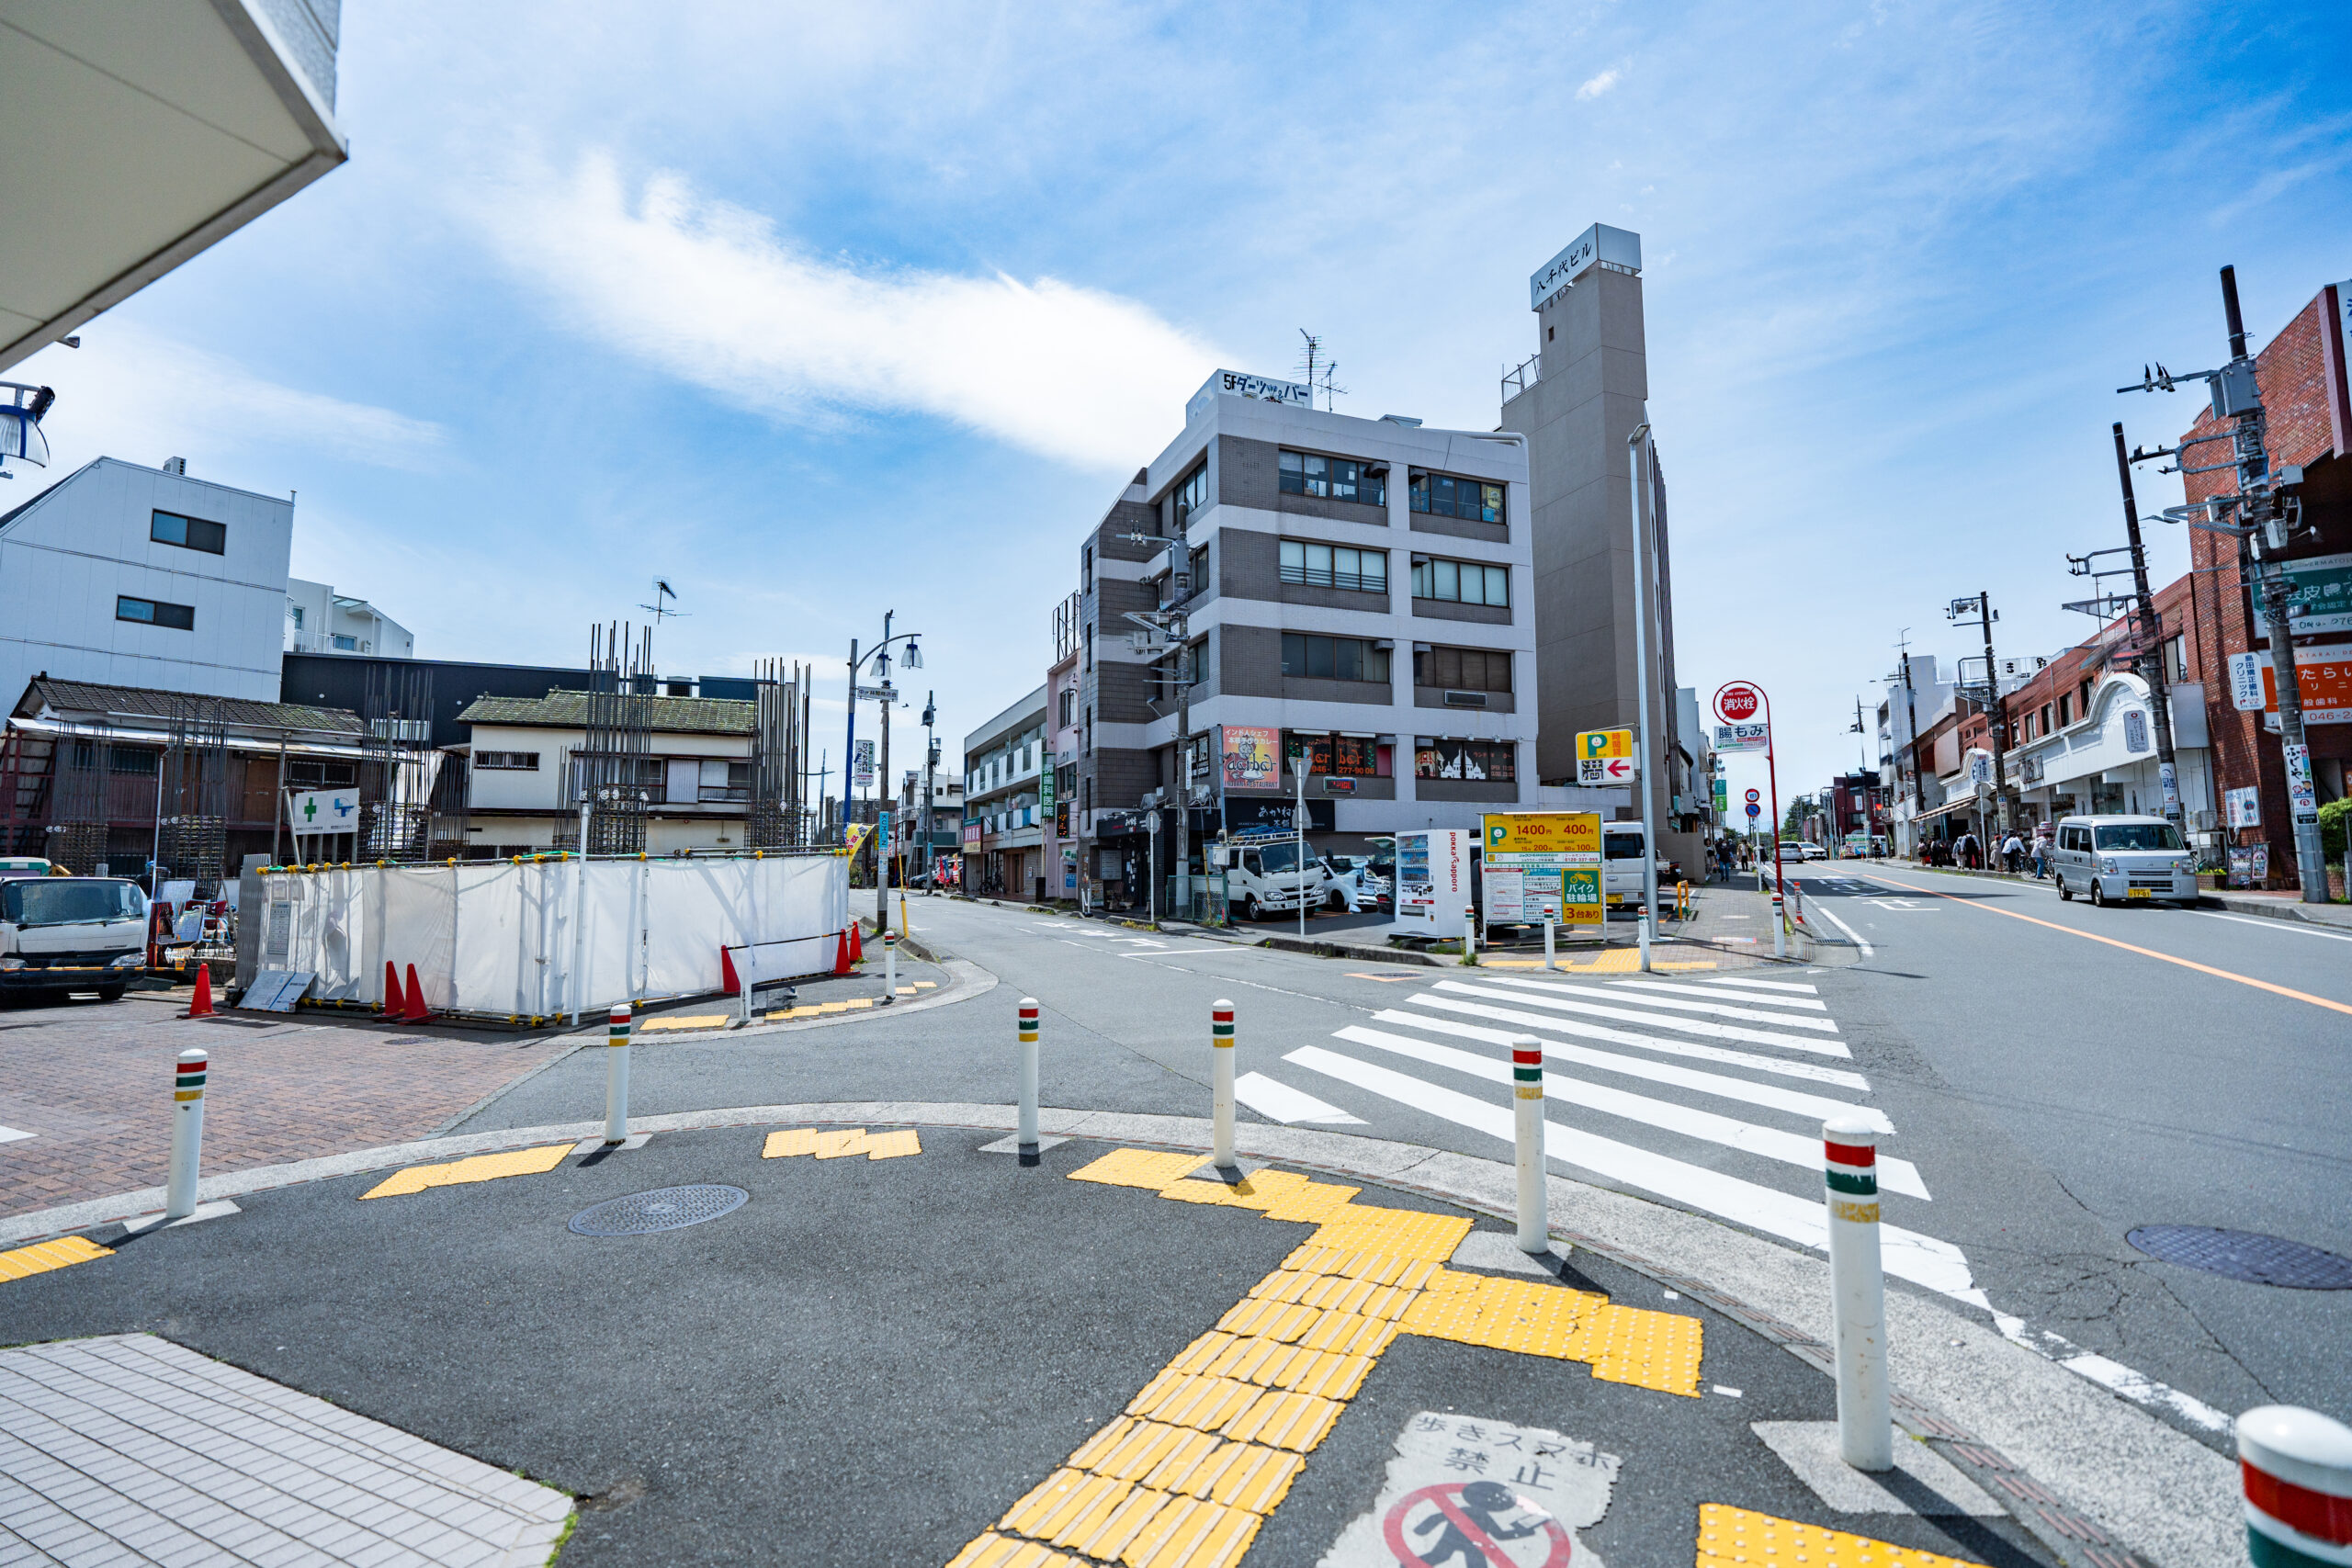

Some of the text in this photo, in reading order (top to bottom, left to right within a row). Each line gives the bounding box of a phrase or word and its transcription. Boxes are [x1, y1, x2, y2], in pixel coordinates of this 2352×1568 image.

[1535, 243, 1592, 296] 八千代ビル
[1724, 695, 1756, 711] 消火栓
[1718, 726, 1764, 739] 腸もみ
[1258, 806, 1295, 818] あかね
[1568, 885, 1595, 893] バイク
[1566, 894, 1598, 903] 駐輪場
[1443, 1446, 1556, 1492] 禁止
